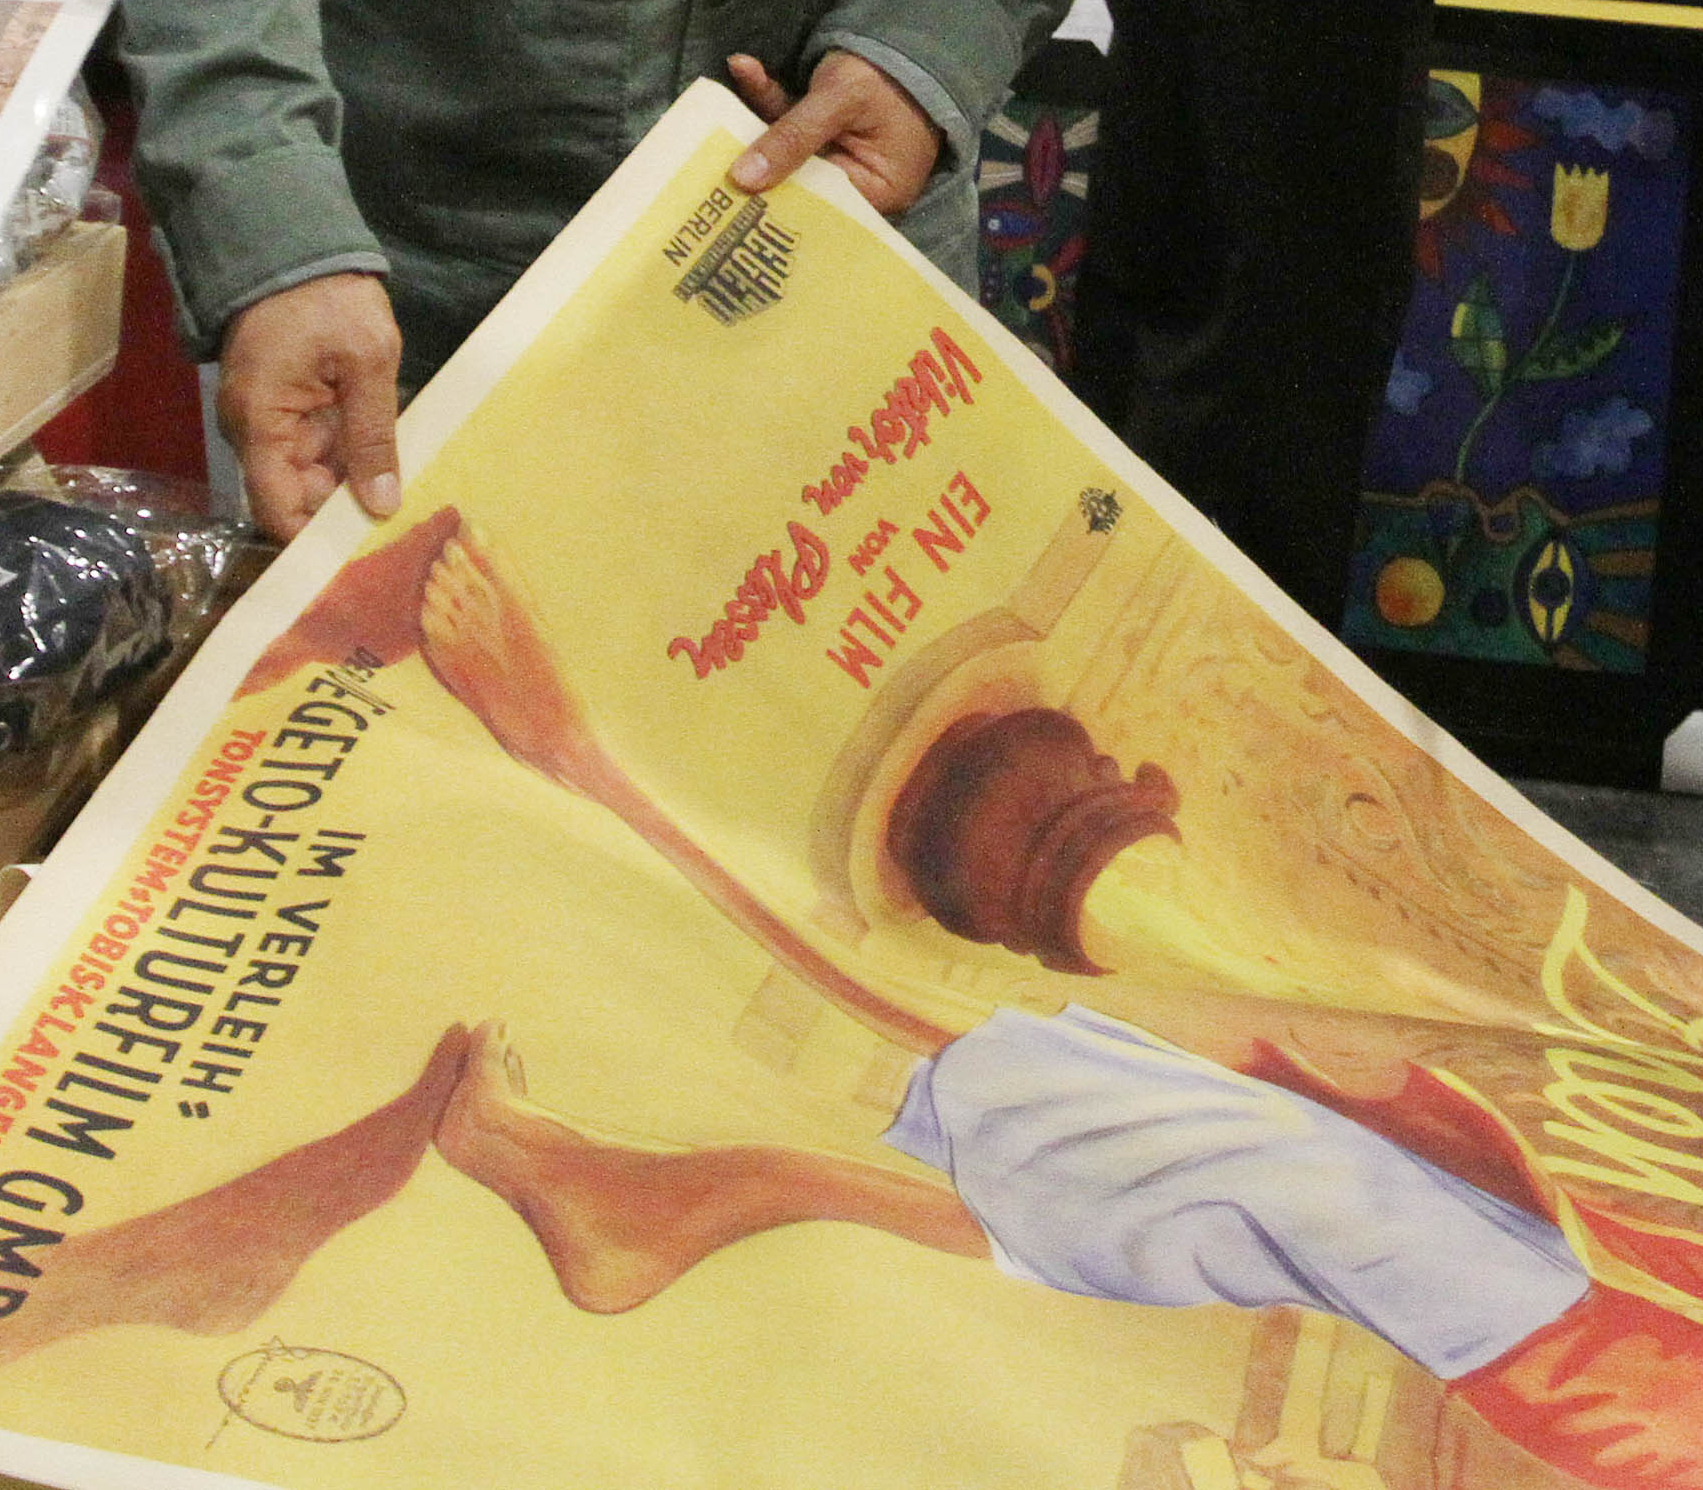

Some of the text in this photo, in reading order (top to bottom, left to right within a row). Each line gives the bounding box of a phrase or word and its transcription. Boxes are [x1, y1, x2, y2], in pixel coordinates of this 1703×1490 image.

[662, 187, 734, 267] BERLIN
[667, 326, 983, 680] Viktor von Plessen
[825, 470, 992, 689] EIN FILM
[847, 517, 900, 576] VON
[296, 828, 367, 877] IM
